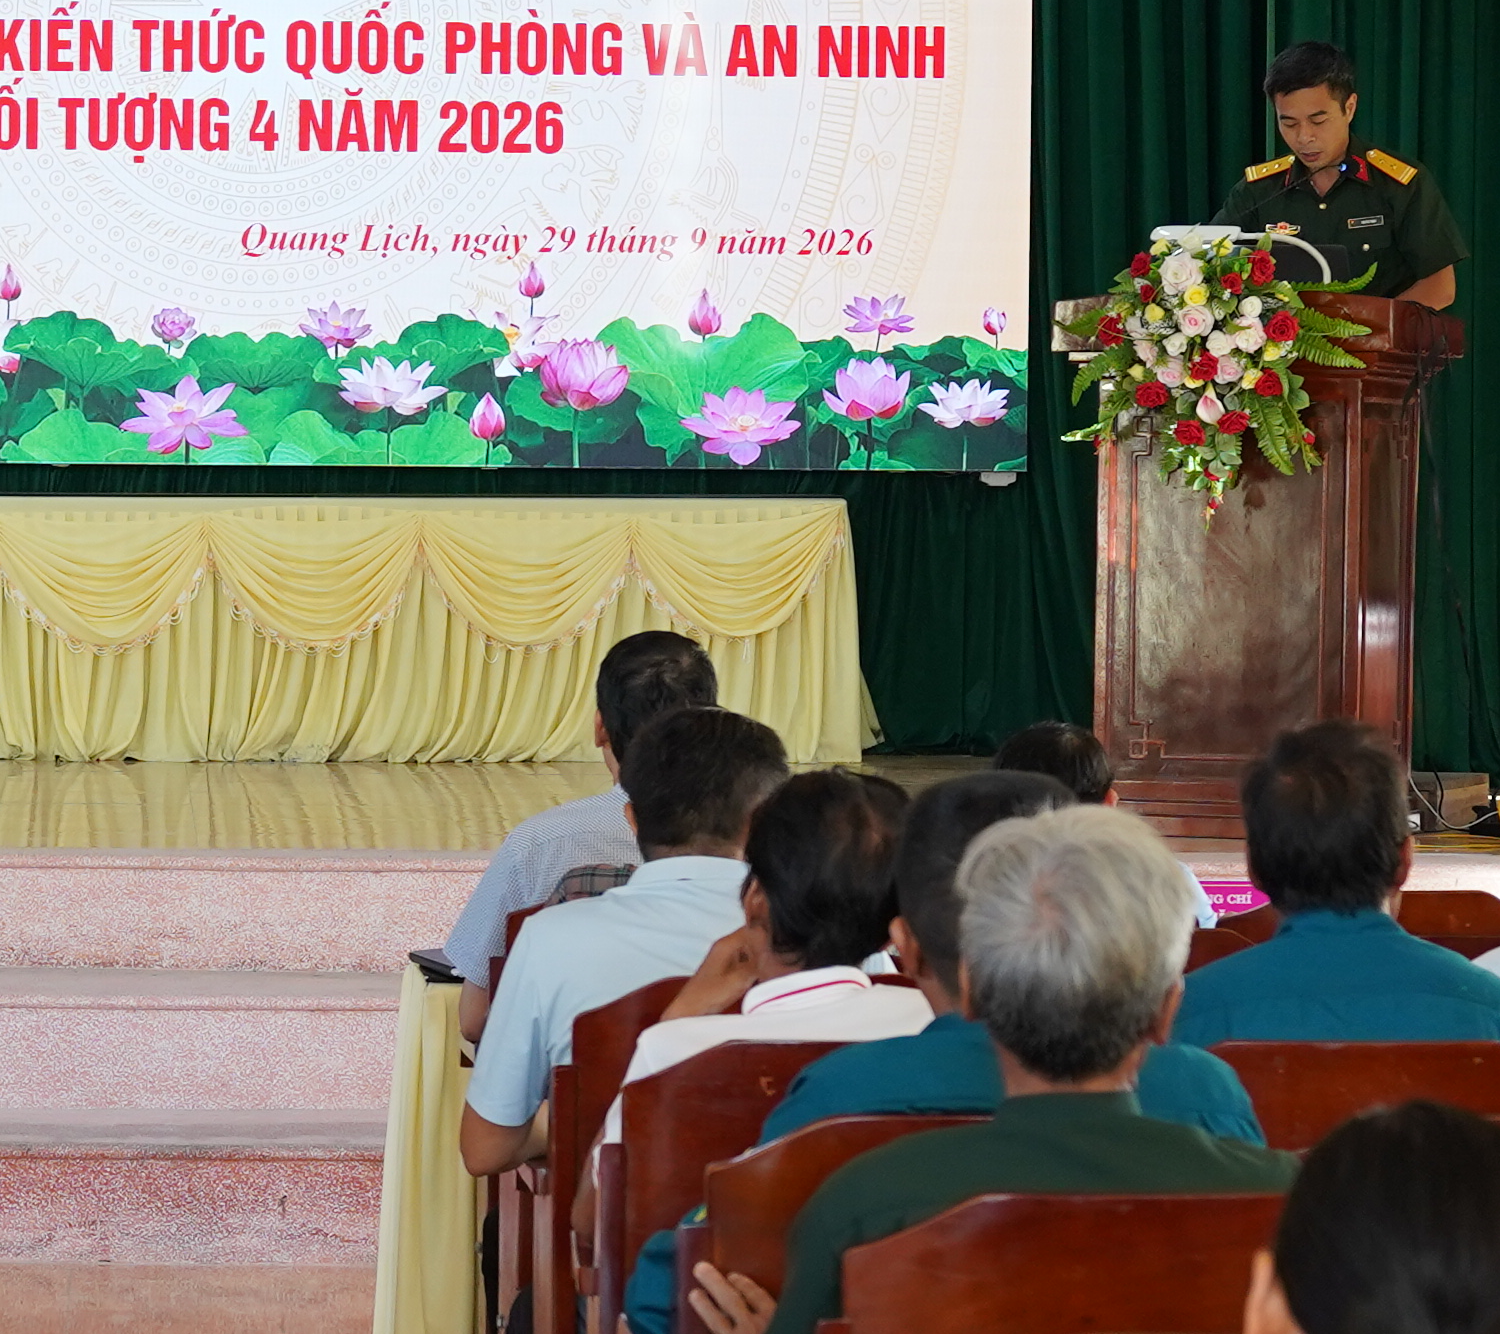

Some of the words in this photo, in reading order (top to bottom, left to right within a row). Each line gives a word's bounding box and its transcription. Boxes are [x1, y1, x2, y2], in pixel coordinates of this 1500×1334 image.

[132, 8, 264, 73] THỨC
[286, 2, 424, 79] QUỐC
[445, 10, 622, 75] PHÒNG
[642, 11, 708, 77] VÀ
[726, 25, 797, 77] AN
[818, 26, 945, 78] NINH
[58, 92, 229, 163] TƯỢNG
[249, 100, 279, 151] 4
[298, 88, 418, 152] NĂM
[438, 101, 563, 154] 2026
[240, 223, 350, 259] Quang
[360, 223, 439, 260] Lịch,
[451, 223, 528, 261] ngày
[539, 225, 576, 255] 29
[586, 223, 678, 261] tháng
[689, 226, 707, 256] 9
[717, 227, 786, 256] năm
[797, 227, 874, 258] 2026
[1226, 891, 1252, 904] CHÍ
